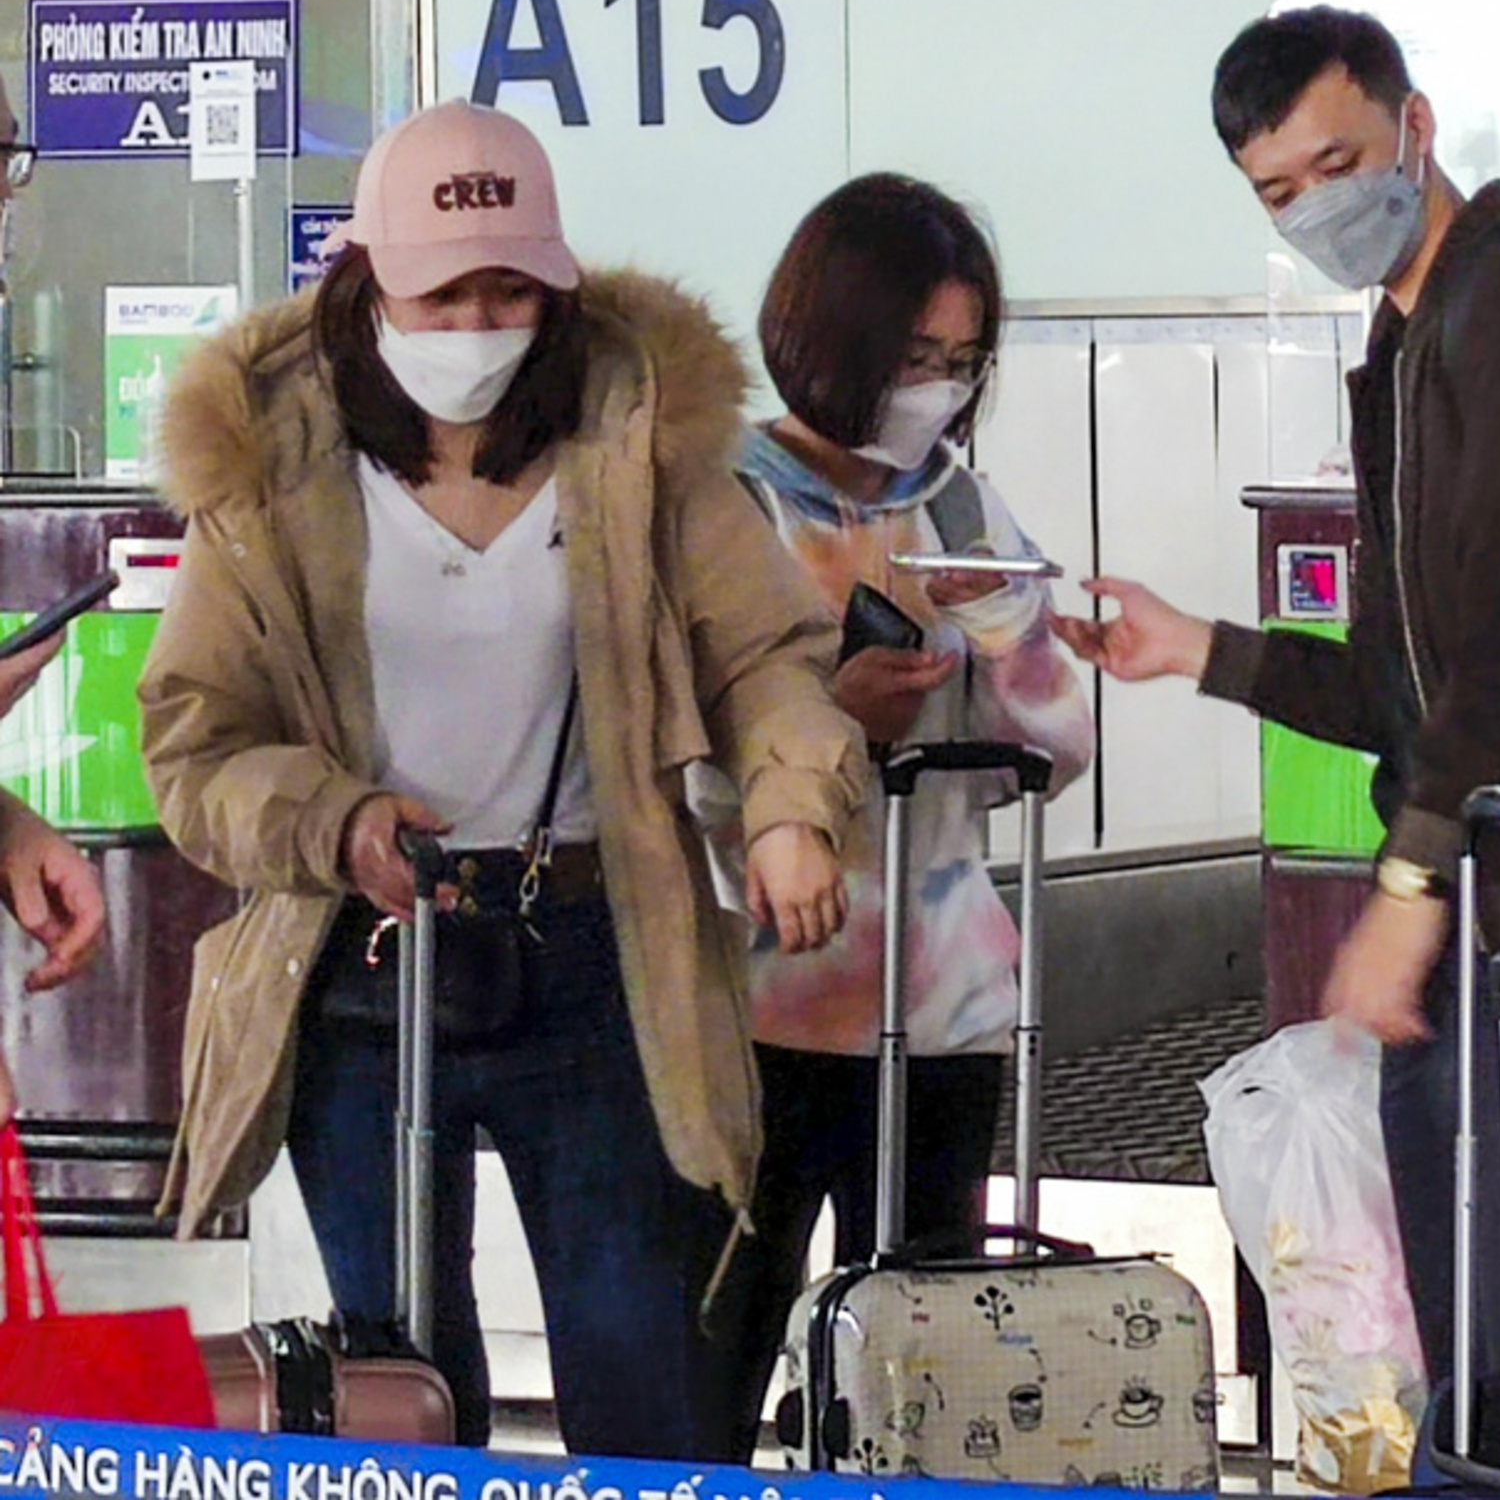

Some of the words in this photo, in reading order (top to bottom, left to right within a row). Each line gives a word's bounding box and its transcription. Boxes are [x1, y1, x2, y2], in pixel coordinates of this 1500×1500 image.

[163, 20, 198, 59] TRA
[203, 19, 233, 57] AN
[237, 19, 286, 58] NINH
[49, 71, 122, 95] SECURITY
[124, 70, 190, 93] INSPECT
[433, 174, 515, 211] CREW
[135, 1445, 272, 1500] HÀNG
